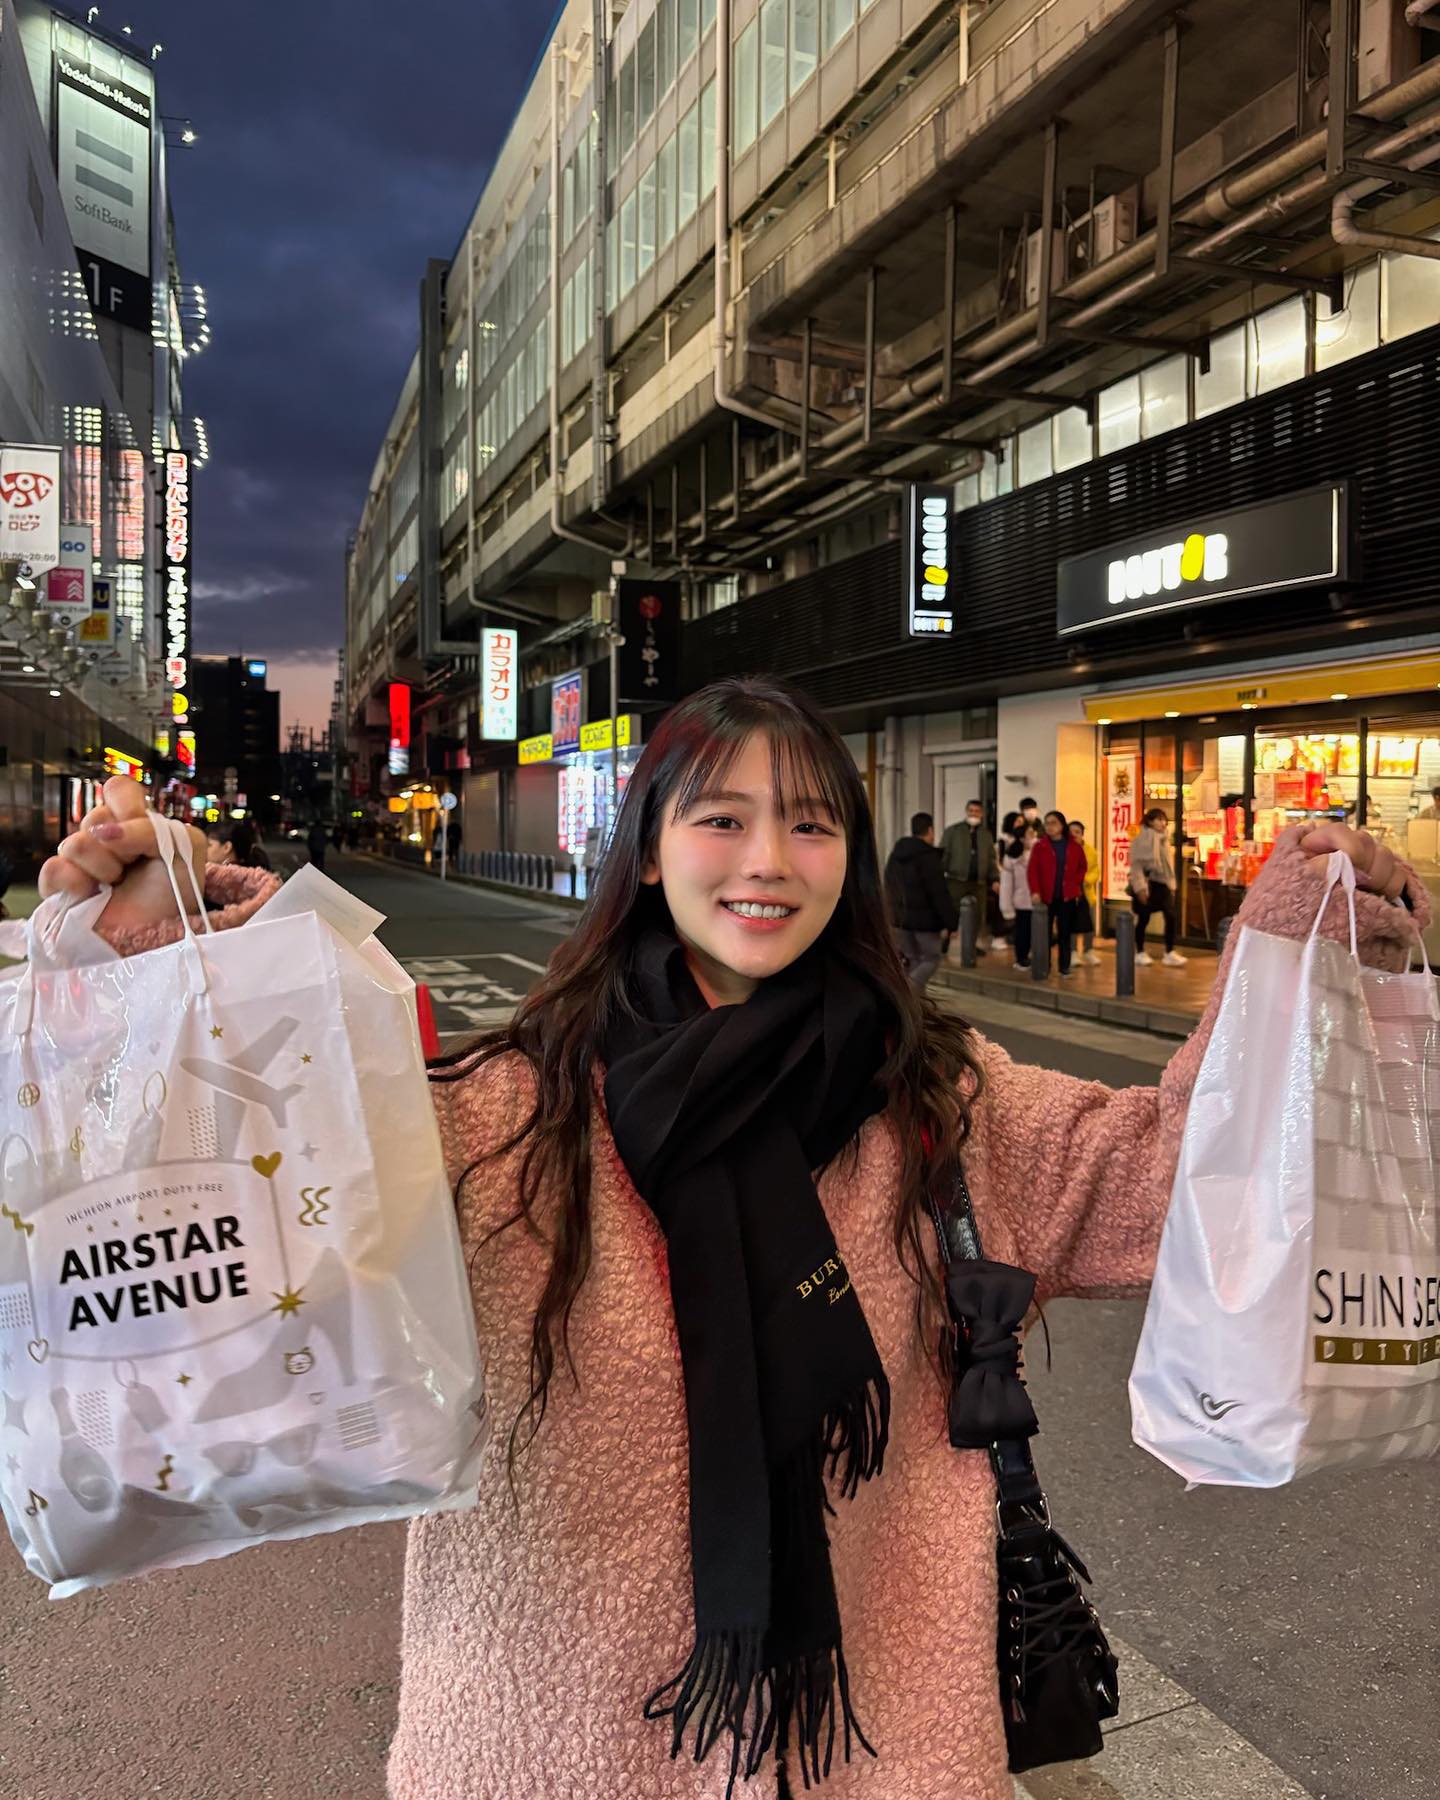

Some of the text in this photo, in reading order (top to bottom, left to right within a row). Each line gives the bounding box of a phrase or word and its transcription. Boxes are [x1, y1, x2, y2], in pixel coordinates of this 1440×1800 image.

[74, 194, 134, 234] SoftBank
[1108, 533, 1228, 604] DOUTOR
[490, 634, 511, 701] カラオケ
[66, 1182, 224, 1226] INCHEON AIRPORT DUTY FREE
[59, 1215, 245, 1285] AIRSTAR
[69, 1262, 248, 1332] AVENUE
[1313, 1268, 1440, 1328] SHINSE
[1323, 1340, 1412, 1361] DUTY
